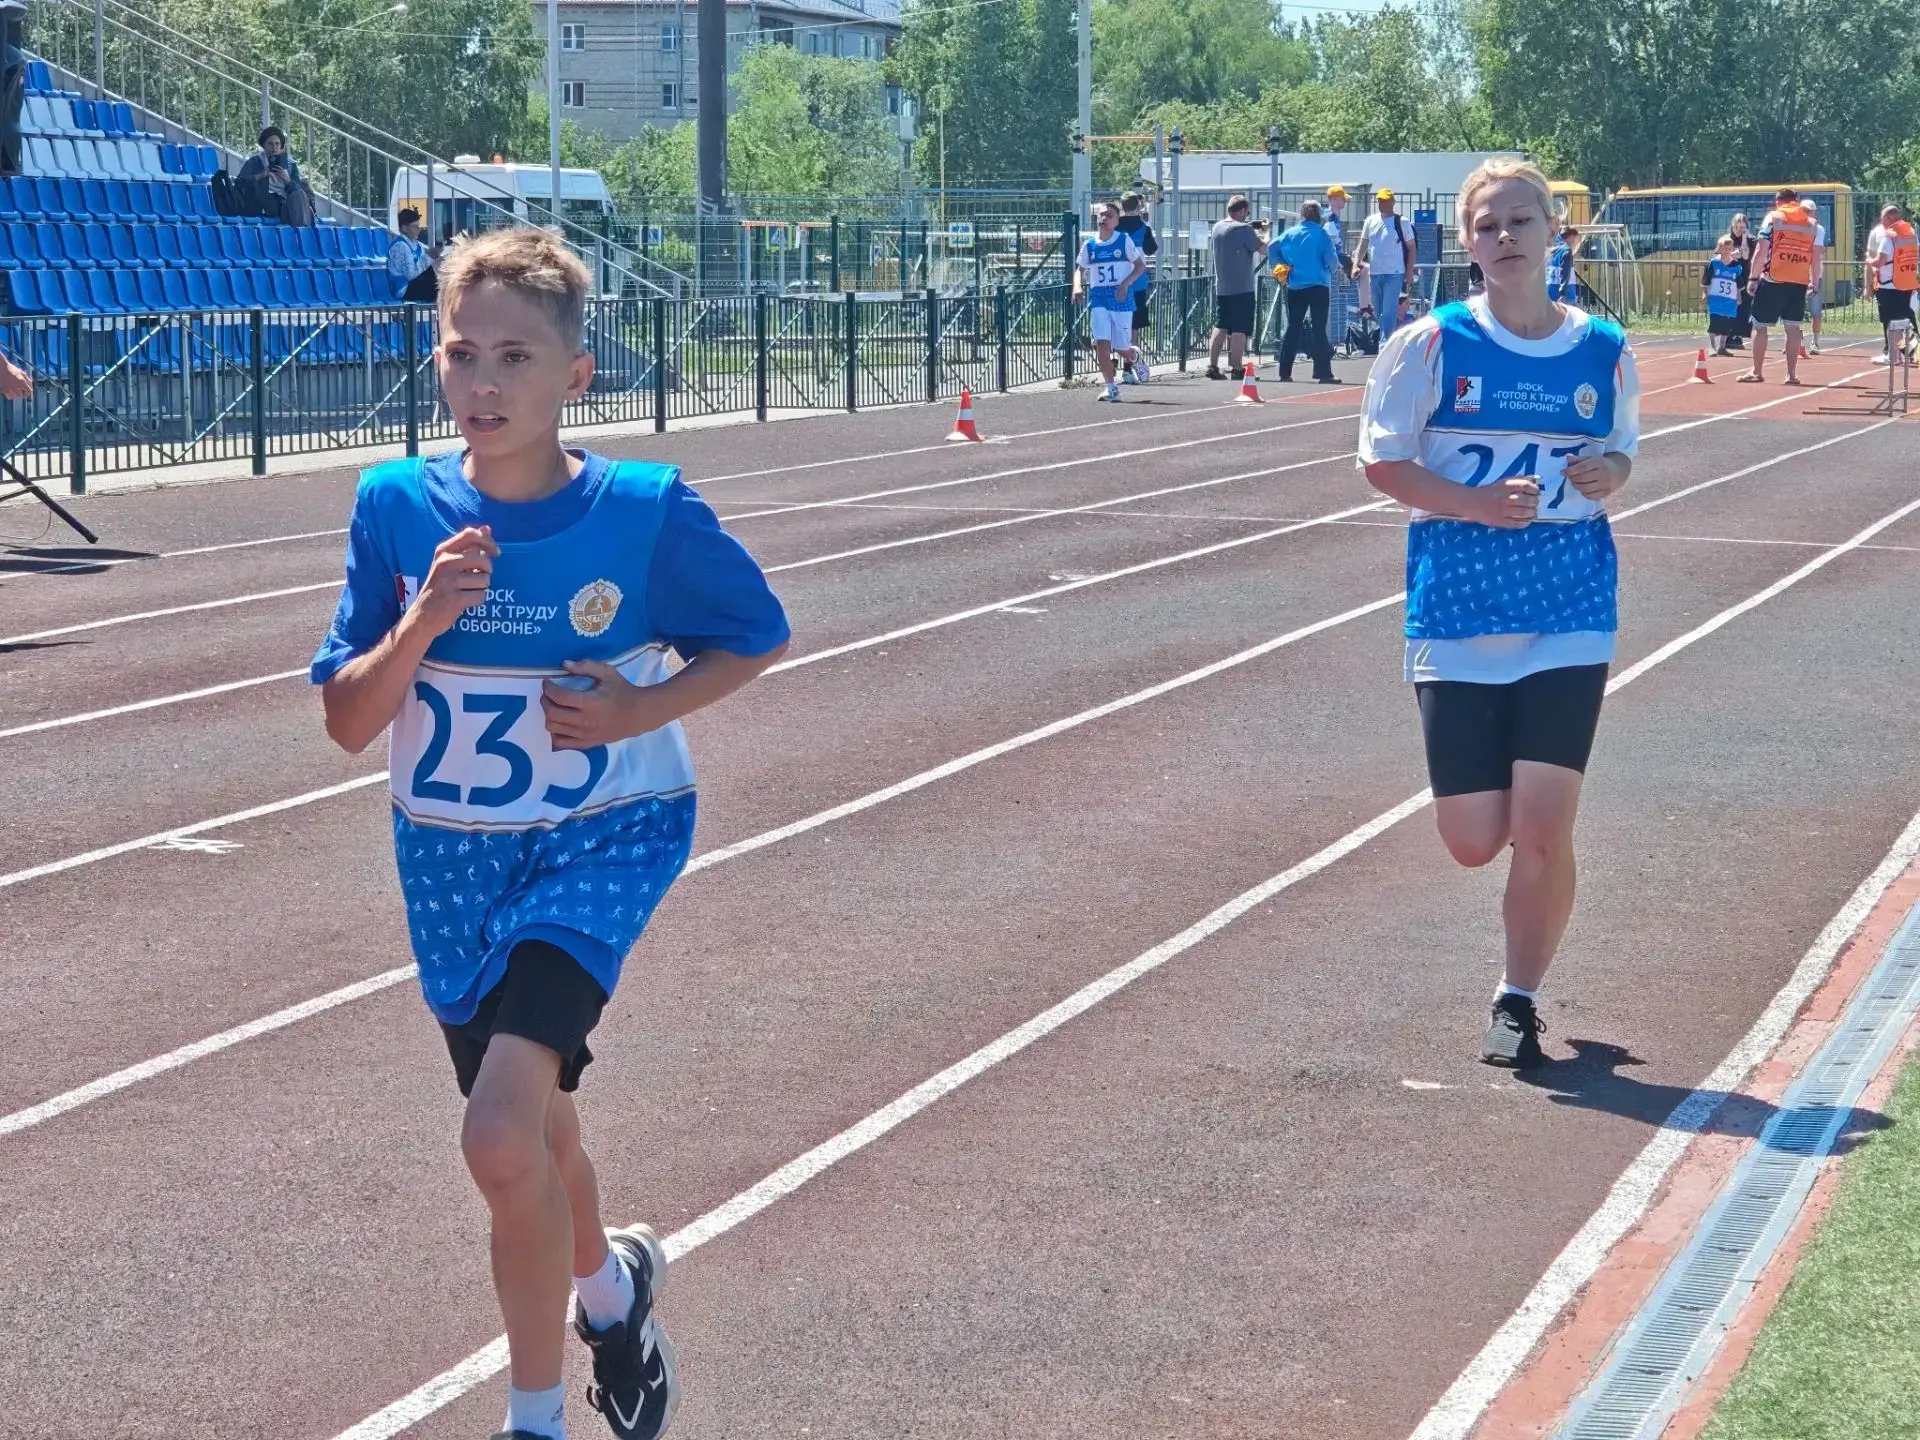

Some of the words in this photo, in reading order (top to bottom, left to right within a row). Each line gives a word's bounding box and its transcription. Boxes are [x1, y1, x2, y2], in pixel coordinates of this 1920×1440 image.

[1097, 264, 1118, 283] 51
[1719, 280, 1732, 295] 53
[1517, 382, 1544, 392] ВФСК
[1493, 391, 1527, 400] «ГОТОВ
[1530, 392, 1537, 401] К
[1539, 393, 1568, 404] ТРУДУ
[1499, 400, 1507, 408] И
[1509, 401, 1560, 412] ОБОРОНЕ»
[491, 605, 502, 618] К
[505, 606, 558, 621] ТРУДУ
[459, 619, 542, 635] ОБОРОНЕ»
